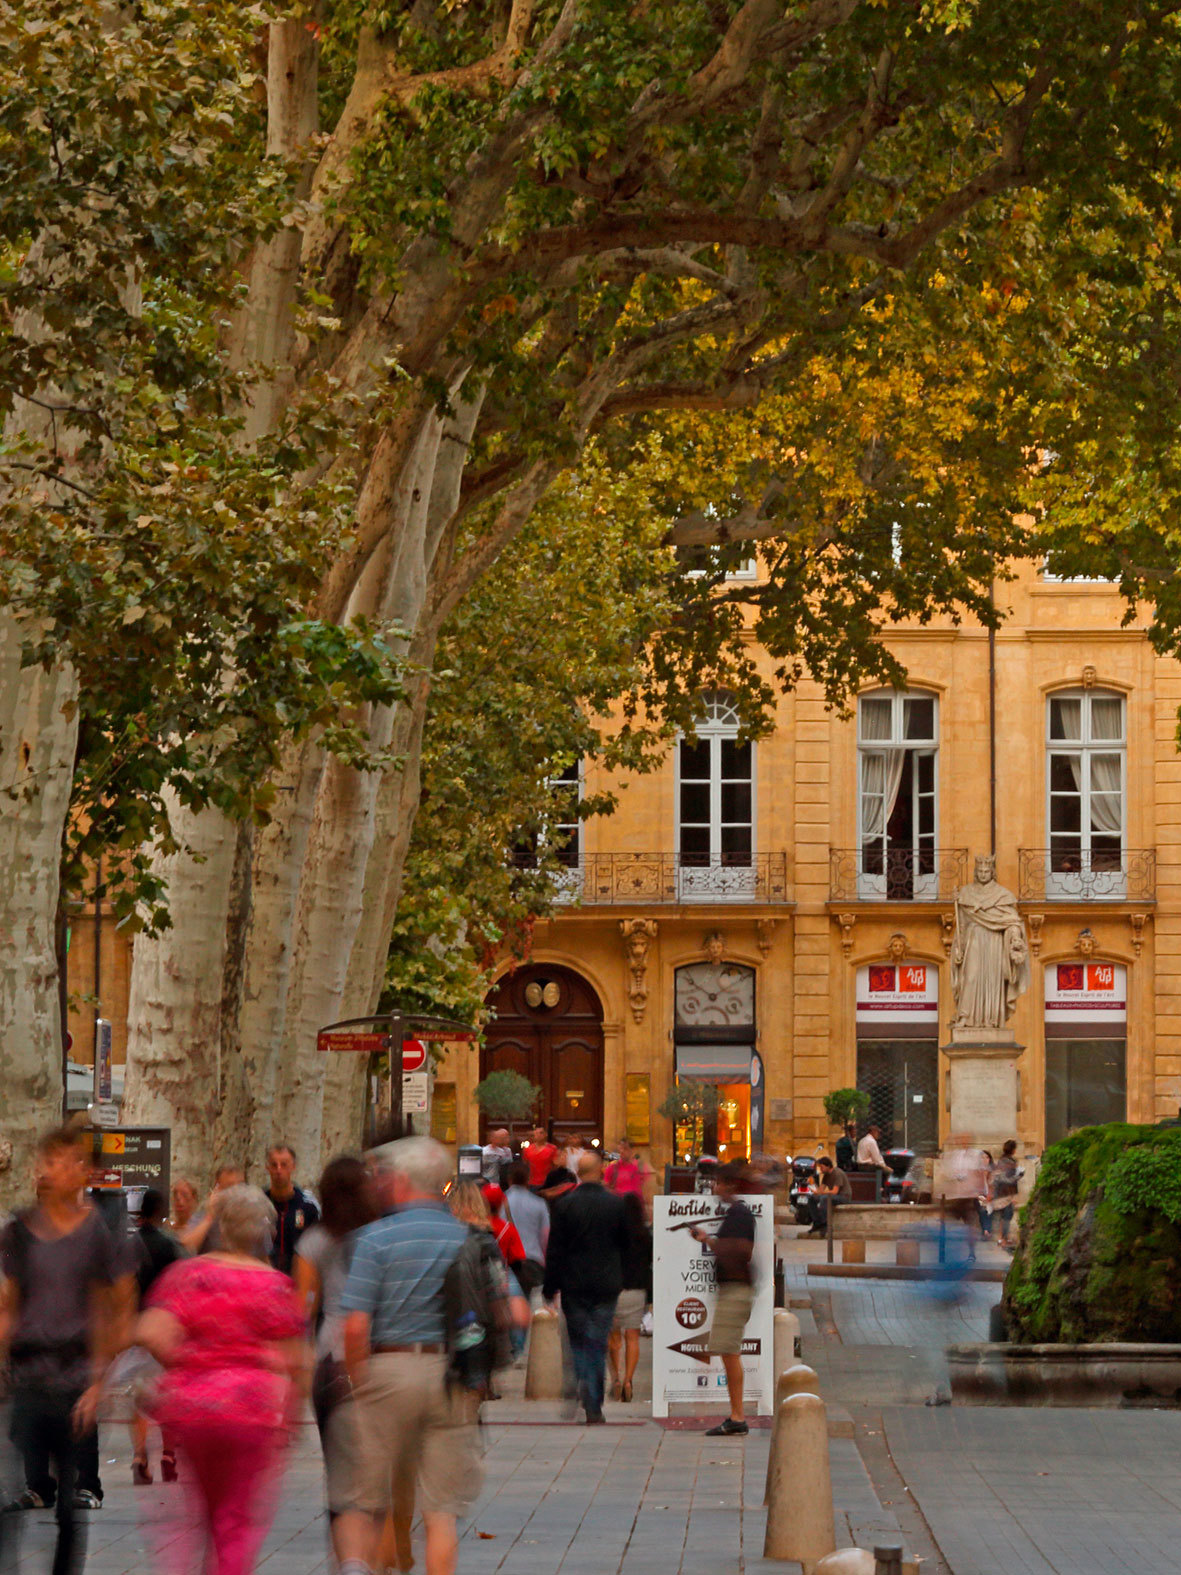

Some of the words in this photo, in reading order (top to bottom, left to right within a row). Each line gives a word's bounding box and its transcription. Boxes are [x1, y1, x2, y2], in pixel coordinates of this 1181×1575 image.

[668, 1199, 711, 1216] Bastide
[689, 1260, 717, 1270] SERV
[681, 1272, 717, 1282] VOITU
[709, 1284, 717, 1292] ET
